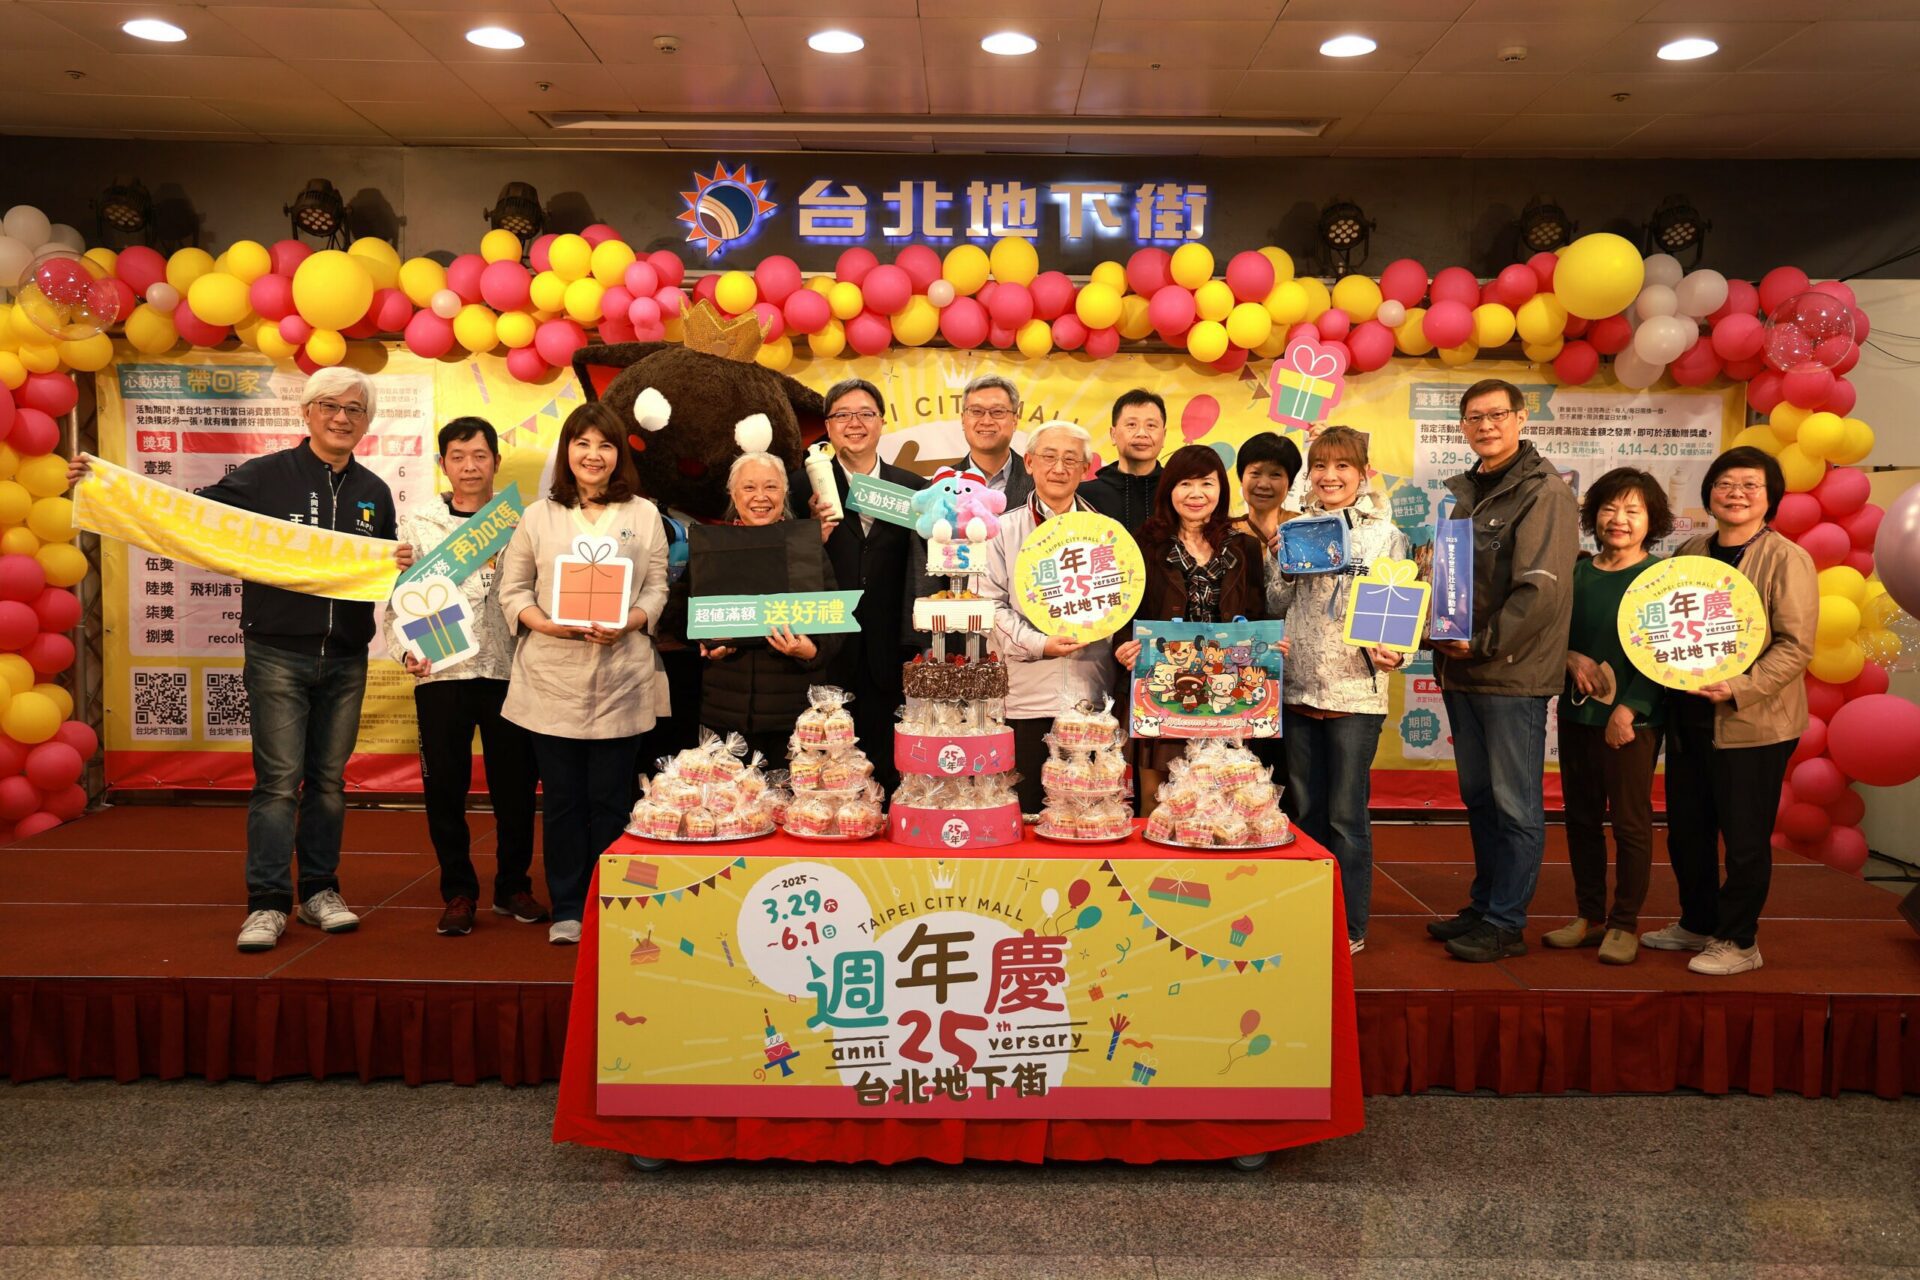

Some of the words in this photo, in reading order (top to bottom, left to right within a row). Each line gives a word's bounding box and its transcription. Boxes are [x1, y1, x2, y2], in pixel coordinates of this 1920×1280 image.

[799, 180, 1208, 239] 台北地下街
[187, 370, 262, 394] 帶回家
[915, 394, 962, 418] CIT
[1617, 442, 1678, 457] 4.14-4.30
[144, 460, 172, 475] 壹獎
[398, 466, 406, 477] 6
[398, 490, 406, 502] 6
[854, 488, 911, 515] 心動好禮
[447, 501, 521, 564] 再加碼
[1031, 544, 1117, 588] 週年慶
[146, 582, 174, 595] 陸獎
[1042, 589, 1061, 597] anni
[1062, 575, 1093, 597] 25
[1093, 576, 1124, 587] versary
[146, 606, 174, 619] 柒獎
[694, 607, 757, 623] 超值滿額
[764, 600, 845, 625] 送好禮
[1048, 592, 1122, 618] 台北地下街
[1637, 590, 1734, 630] 週年慶
[146, 630, 174, 644] 捌獎
[1648, 633, 1669, 641] anni
[1671, 621, 1706, 643] 25
[1706, 624, 1742, 633] versary
[1654, 640, 1738, 663] 台北地下街
[1408, 716, 1432, 728] 期間
[1408, 729, 1432, 741] 限定
[944, 751, 959, 761] 25
[948, 825, 962, 834] 25
[781, 875, 807, 888] 2025
[762, 890, 821, 924] 3.29
[857, 902, 916, 934] TAIPEI
[925, 896, 967, 910] CITY
[977, 898, 1023, 921] MALL
[806, 923, 1069, 1029] 週年慶
[996, 1021, 1012, 1033] th
[831, 1041, 885, 1061] anni
[897, 1010, 989, 1073] 25
[988, 1032, 1083, 1052] versary
[854, 1062, 1048, 1106] 台北地下街
